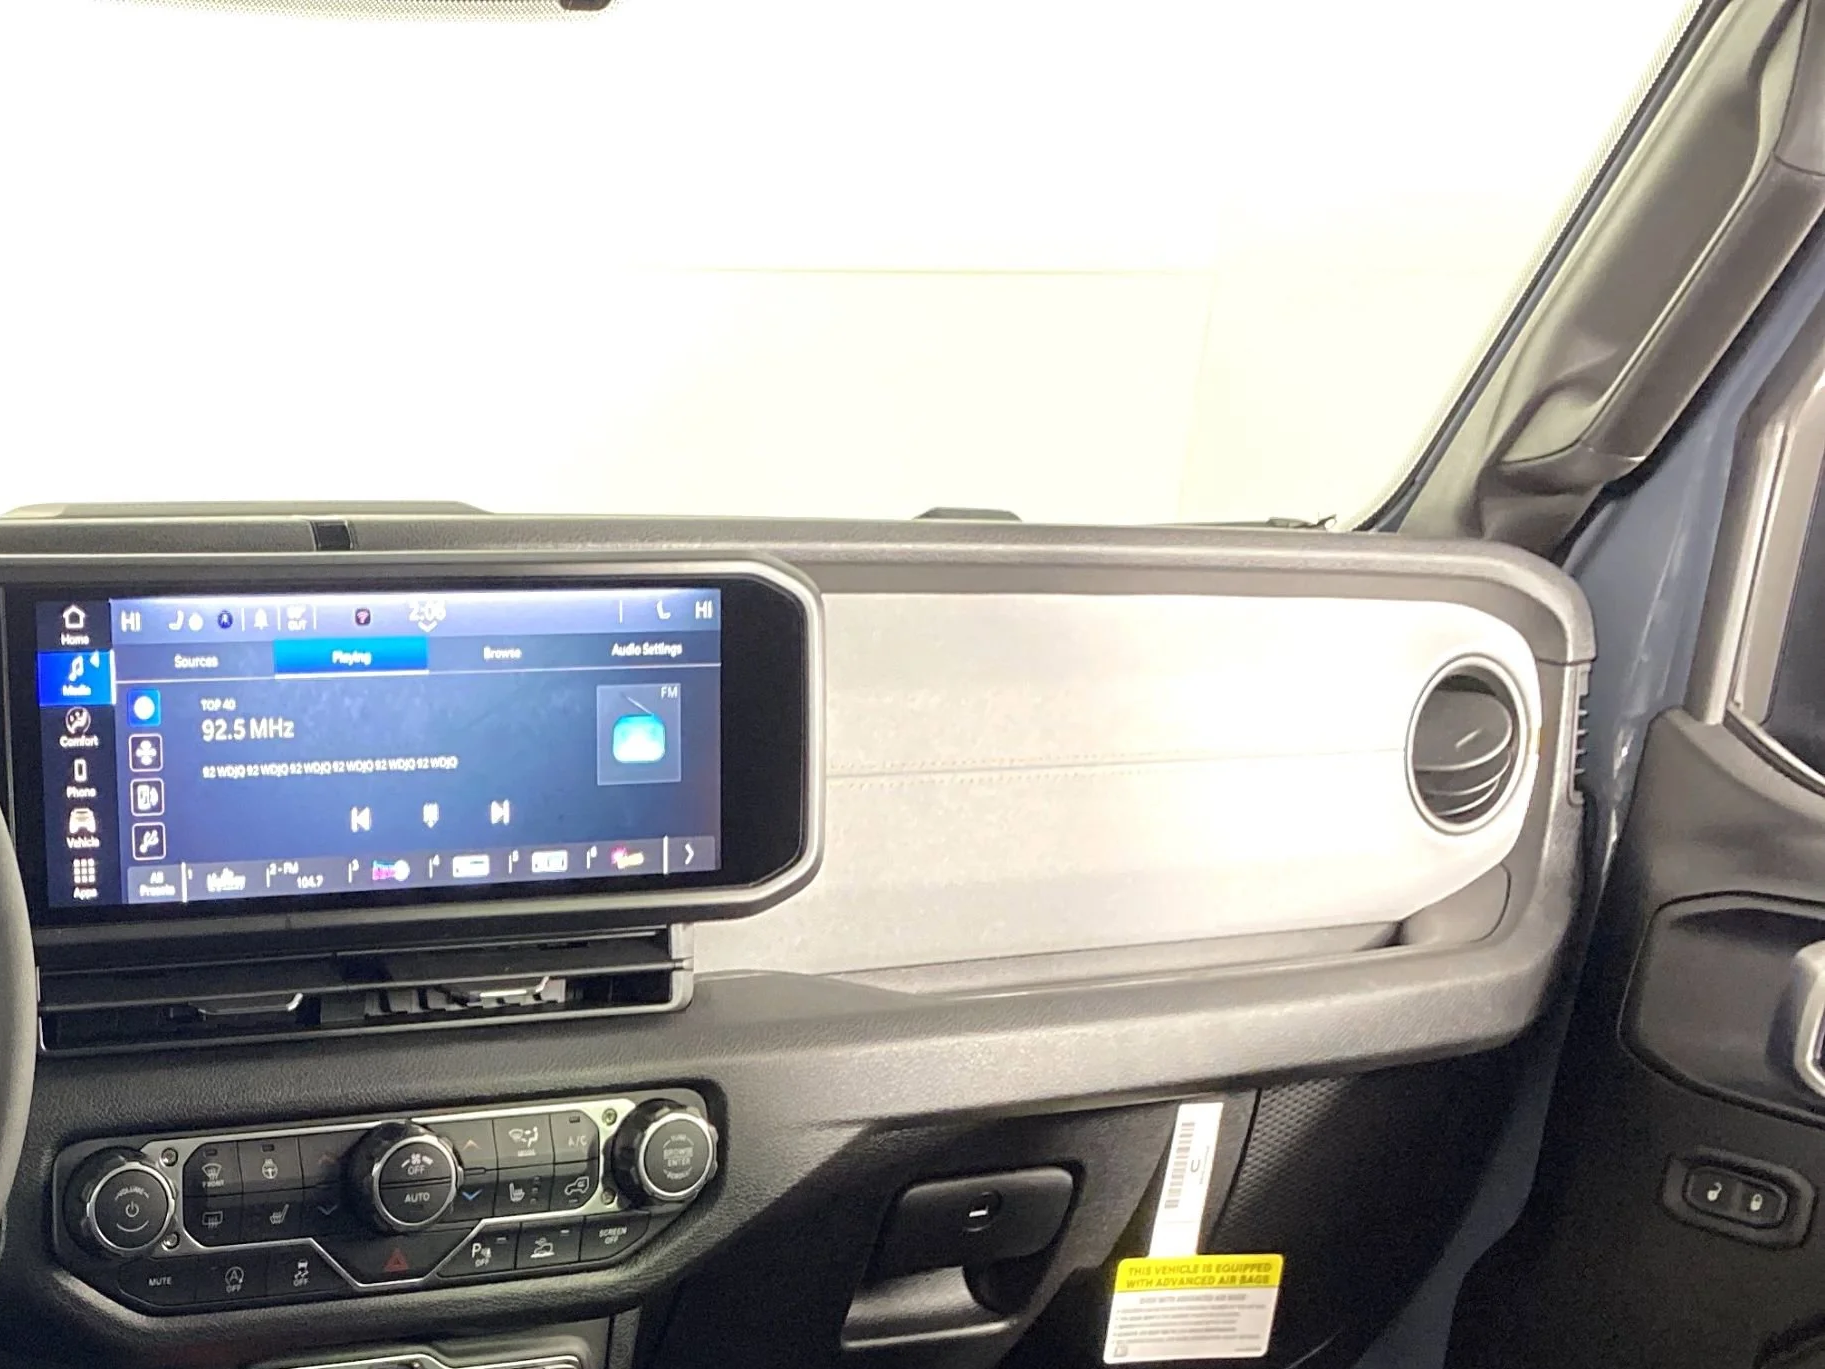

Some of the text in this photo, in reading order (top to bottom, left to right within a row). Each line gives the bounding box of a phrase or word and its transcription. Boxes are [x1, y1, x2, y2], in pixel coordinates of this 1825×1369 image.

[695, 600, 713, 619] HI
[120, 611, 141, 632] HI
[60, 633, 90, 646] Home
[483, 647, 522, 661] Browse
[611, 641, 683, 657] Audio Settings
[174, 654, 219, 669] Sources
[332, 649, 372, 666] Playing
[62, 685, 92, 697] Media
[660, 686, 678, 698] FM
[200, 698, 237, 711] TOP 40
[201, 715, 295, 742] 92.5 MHz
[59, 734, 99, 748] Comfort
[66, 786, 97, 798] Phone
[66, 836, 101, 849] Vehicle
[296, 875, 324, 888] 104.7
[72, 886, 98, 900] Apps
[568, 1135, 588, 1147] A/C
[407, 1165, 425, 1176] OFF
[404, 1191, 431, 1204] AUTO
[599, 1227, 628, 1238] SCREEN
[1128, 1262, 1272, 1276] THIS VEHICLE IS EQUIPPED
[148, 1276, 173, 1287] MUTE
[293, 1277, 309, 1288] OFF
[1126, 1274, 1270, 1289] WITH ADVANCED AIR BAGS
[225, 1284, 242, 1293] OFF
